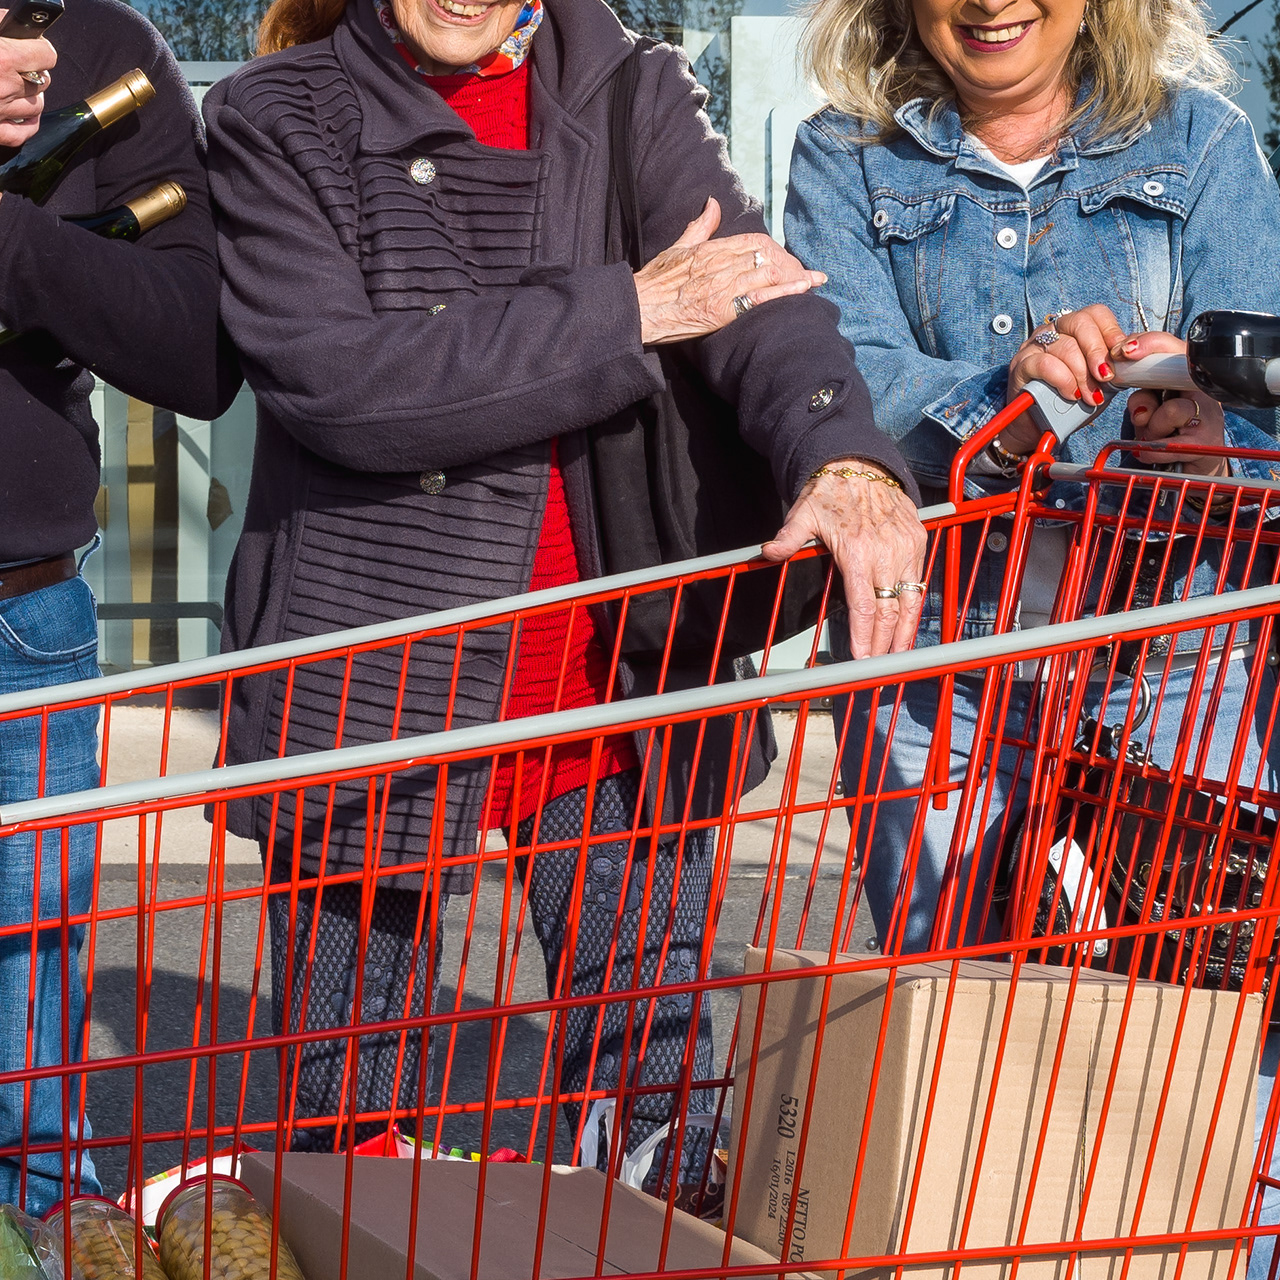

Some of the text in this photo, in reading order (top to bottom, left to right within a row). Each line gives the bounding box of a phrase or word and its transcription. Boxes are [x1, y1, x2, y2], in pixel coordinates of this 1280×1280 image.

[776, 1093, 800, 1140] 5320
[767, 1157, 782, 1220] 16/01/2024
[783, 1150, 796, 1185] L2016
[792, 1187, 810, 1241] NETTO
